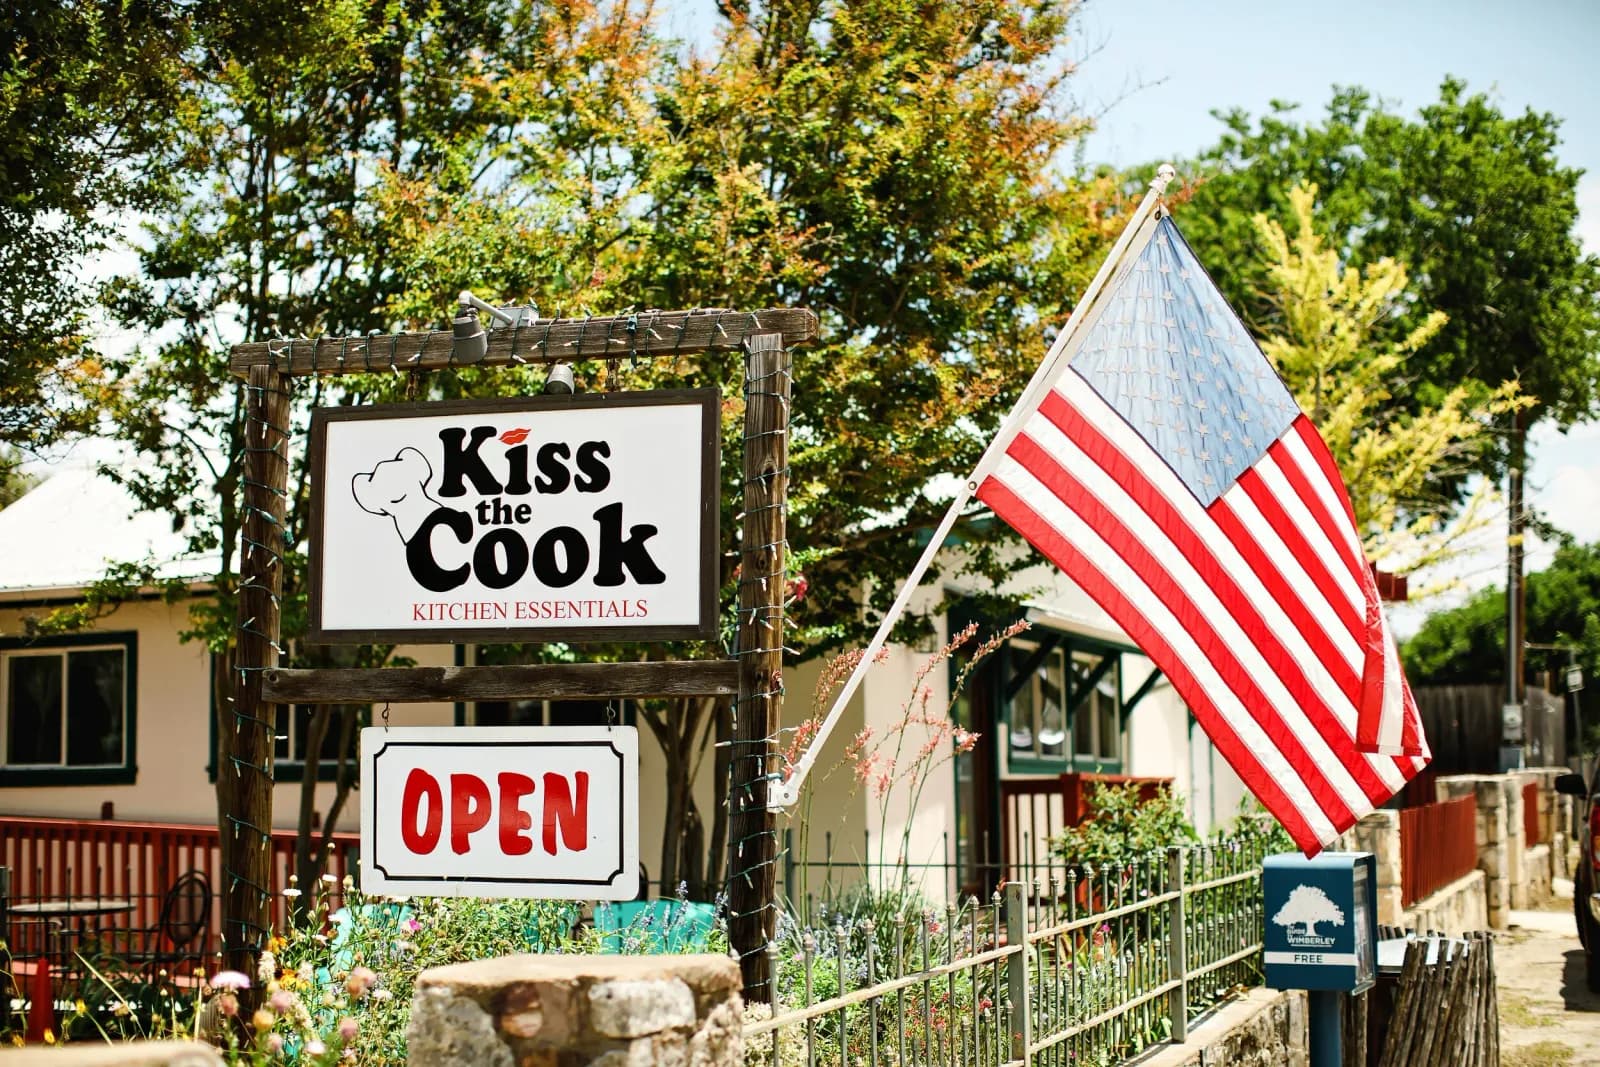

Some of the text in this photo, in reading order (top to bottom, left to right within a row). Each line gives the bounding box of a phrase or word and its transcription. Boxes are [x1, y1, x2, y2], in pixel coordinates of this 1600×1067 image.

[438, 426, 611, 497] Kiss
[475, 498, 532, 525] the
[406, 502, 666, 593] Cook
[412, 599, 648, 621] KITCHEN ESSENTIALS
[401, 767, 589, 856] OPEN
[1294, 954, 1323, 963] FREE
